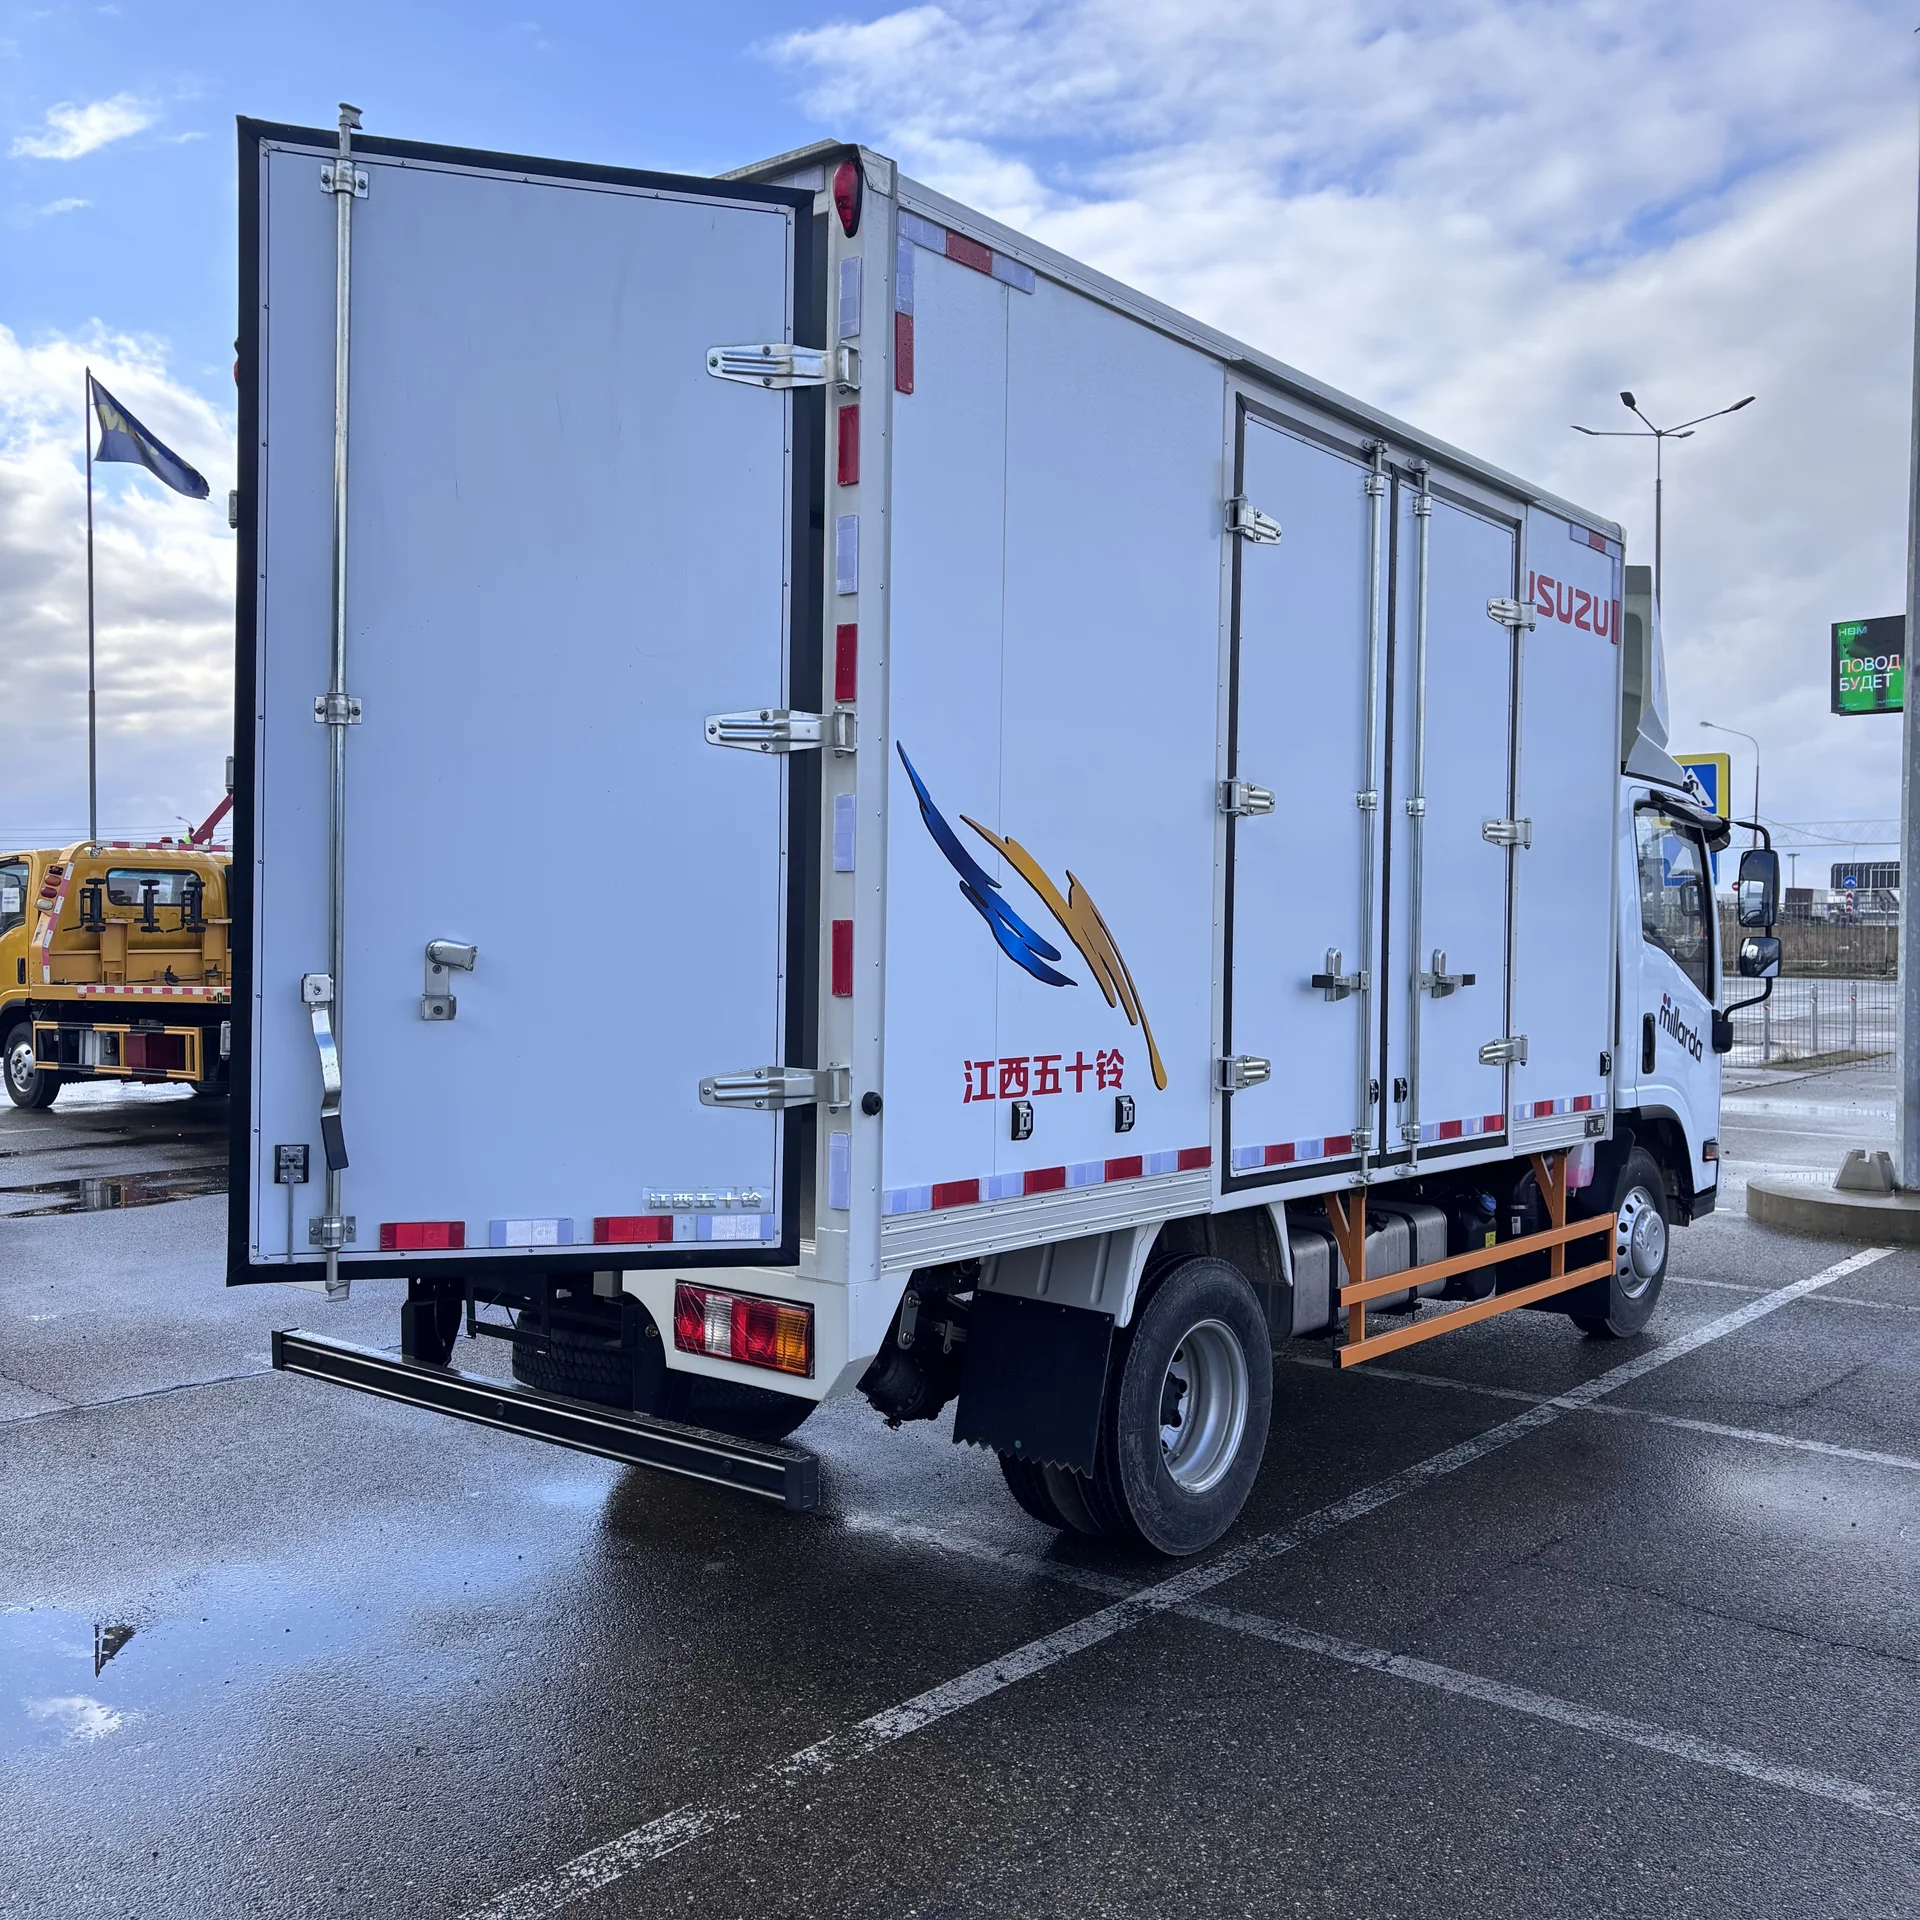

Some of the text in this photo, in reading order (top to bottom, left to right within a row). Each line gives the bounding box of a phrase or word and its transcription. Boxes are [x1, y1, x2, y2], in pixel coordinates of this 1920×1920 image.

[1529, 570, 1609, 637] ISUZU
[1839, 654, 1901, 674] ПОВОД
[1839, 673, 1894, 692] БУДЕТ
[1658, 1003, 1703, 1063] millarda
[962, 1048, 1124, 1104] 江西五十铃
[649, 1191, 763, 1210] 江西五十铃
